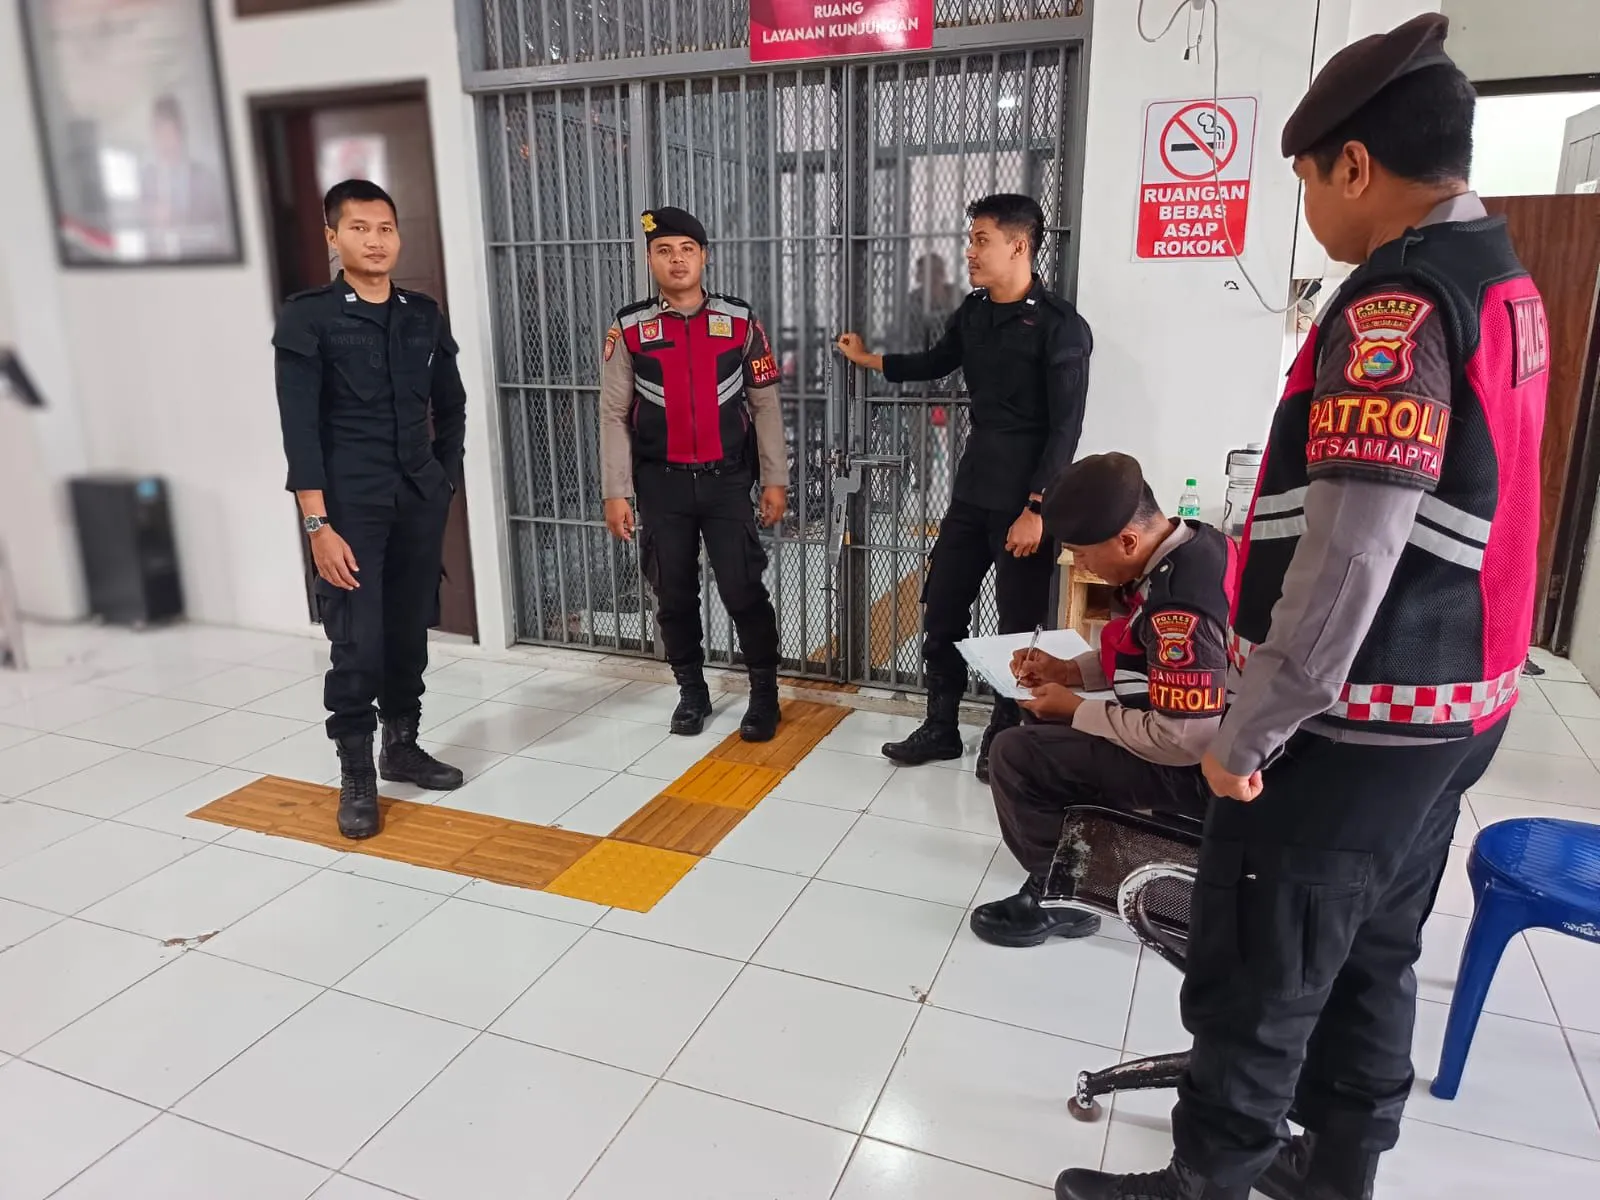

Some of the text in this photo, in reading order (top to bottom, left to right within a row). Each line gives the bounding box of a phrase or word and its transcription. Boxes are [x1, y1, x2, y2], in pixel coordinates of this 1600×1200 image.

[814, 2, 864, 19] RUANG
[762, 17, 919, 44] LAYANAN KUNJUNGAN
[1143, 185, 1246, 203] RUANGAN
[1159, 204, 1227, 220] BEBAS
[1163, 222, 1219, 238] ASAP
[1153, 239, 1228, 255] ROKOK
[1356, 300, 1417, 316] POLRES
[751, 354, 777, 375] PAT
[1156, 615, 1190, 624] POLRES
[1150, 683, 1224, 710] ATROLI
